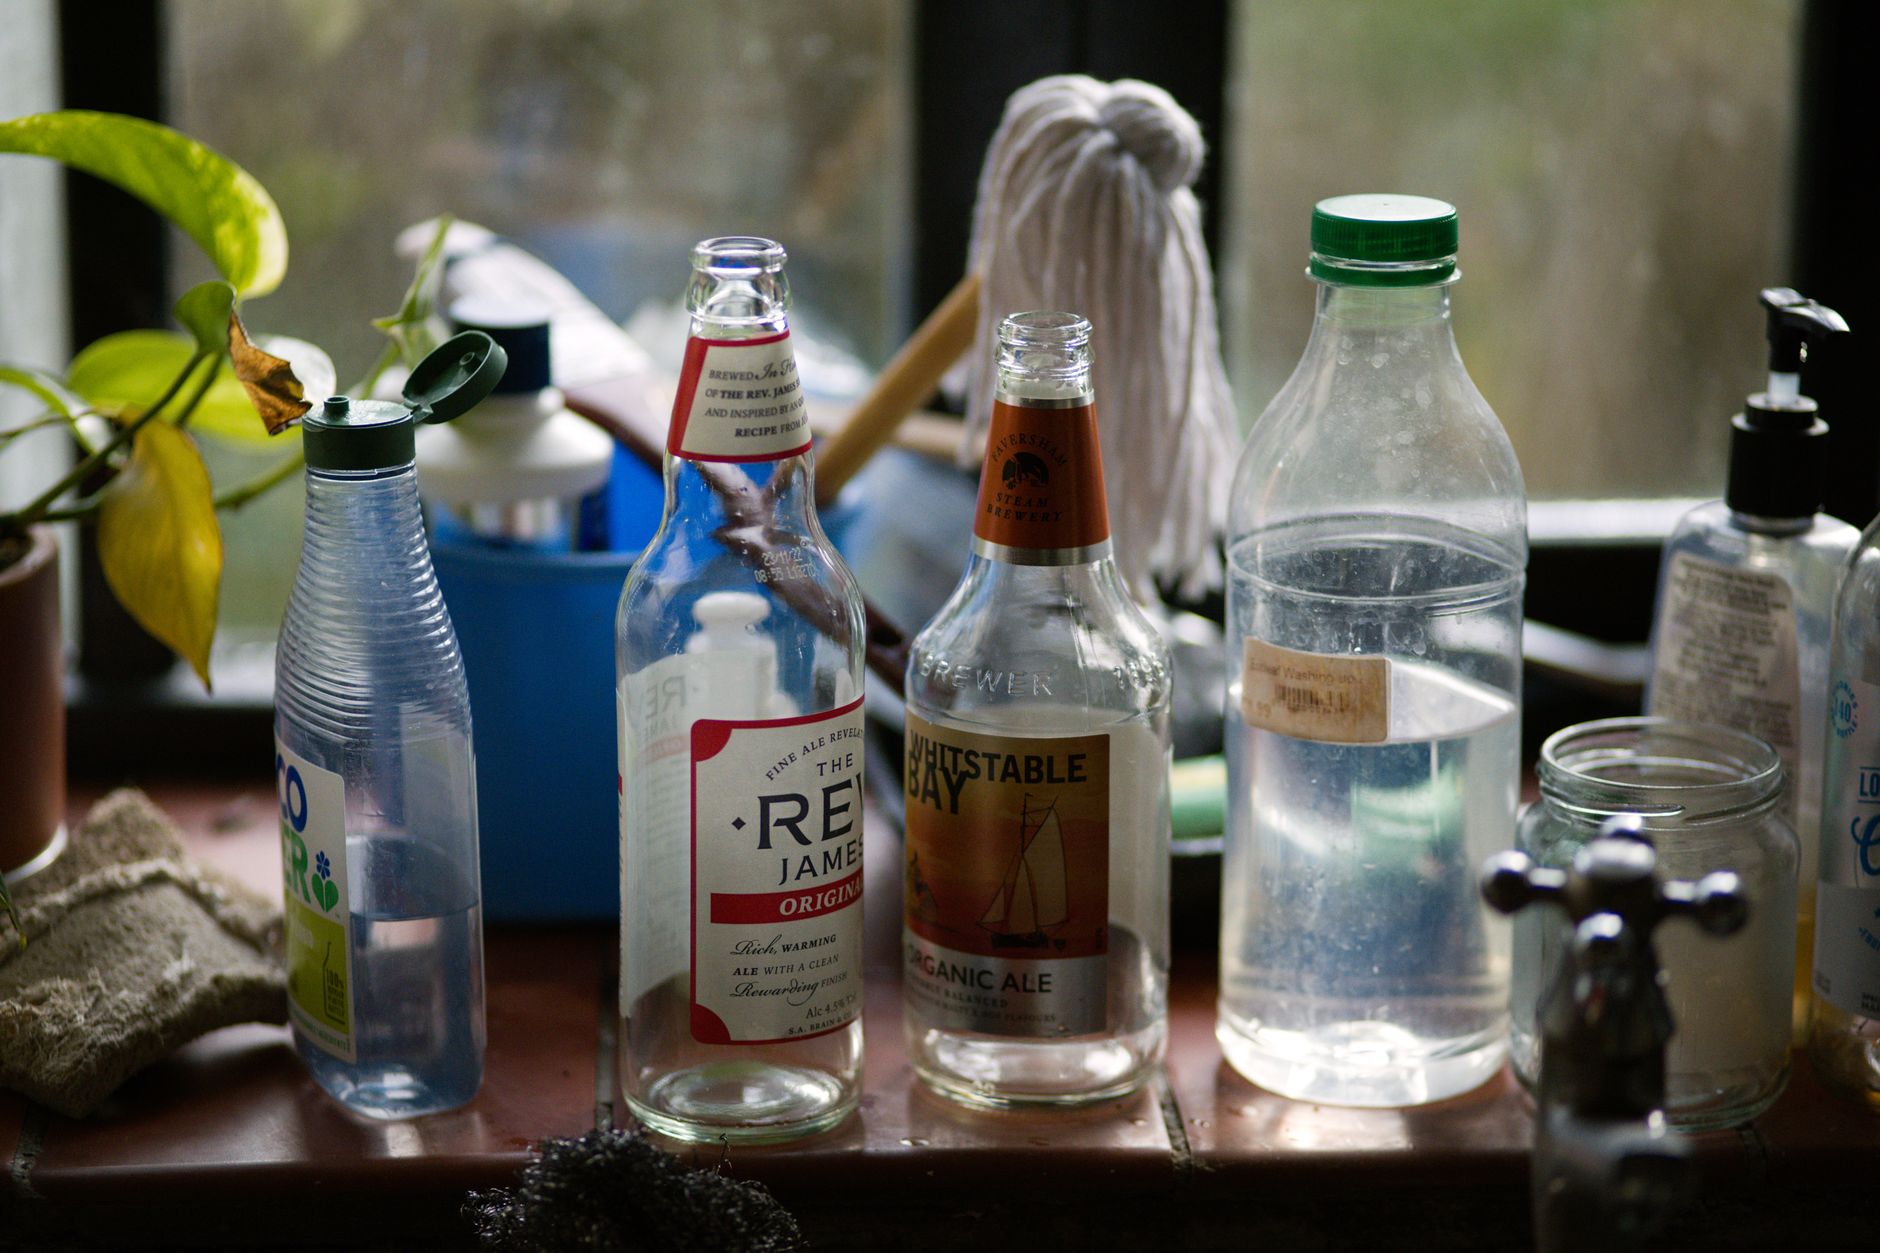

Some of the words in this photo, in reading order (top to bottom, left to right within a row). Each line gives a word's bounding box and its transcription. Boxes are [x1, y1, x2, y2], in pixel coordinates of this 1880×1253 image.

[708, 368, 754, 381] BREWED
[755, 362, 778, 381] In
[705, 388, 720, 398] OF
[720, 390, 743, 399] THE
[746, 391, 771, 399] REV.
[773, 382, 796, 399] JAMES
[704, 407, 727, 417] AND
[730, 407, 777, 418] INSPIRED
[779, 405, 790, 415] BY
[734, 424, 778, 437] RECIPE
[995, 492, 1049, 508] STEAM
[986, 503, 1063, 523] BREWERY
[765, 752, 798, 781] FINE
[802, 737, 826, 755] ALE
[816, 752, 853, 777] THE
[910, 729, 1088, 784] WHITSTABLE
[907, 749, 969, 815] BAY
[729, 933, 782, 956] Rich,
[782, 934, 837, 953] WARMING
[732, 967, 759, 976] ALE
[764, 964, 794, 975] WITH
[797, 963, 805, 972] A
[809, 953, 840, 970] CLEAN
[729, 978, 820, 1007] Rewarding
[820, 971, 848, 988] FINISH
[1001, 972, 1052, 993] ALE
[805, 1006, 823, 1019] Alc
[788, 1026, 807, 1035] S.A.
[810, 1018, 835, 1031] BRAIN
